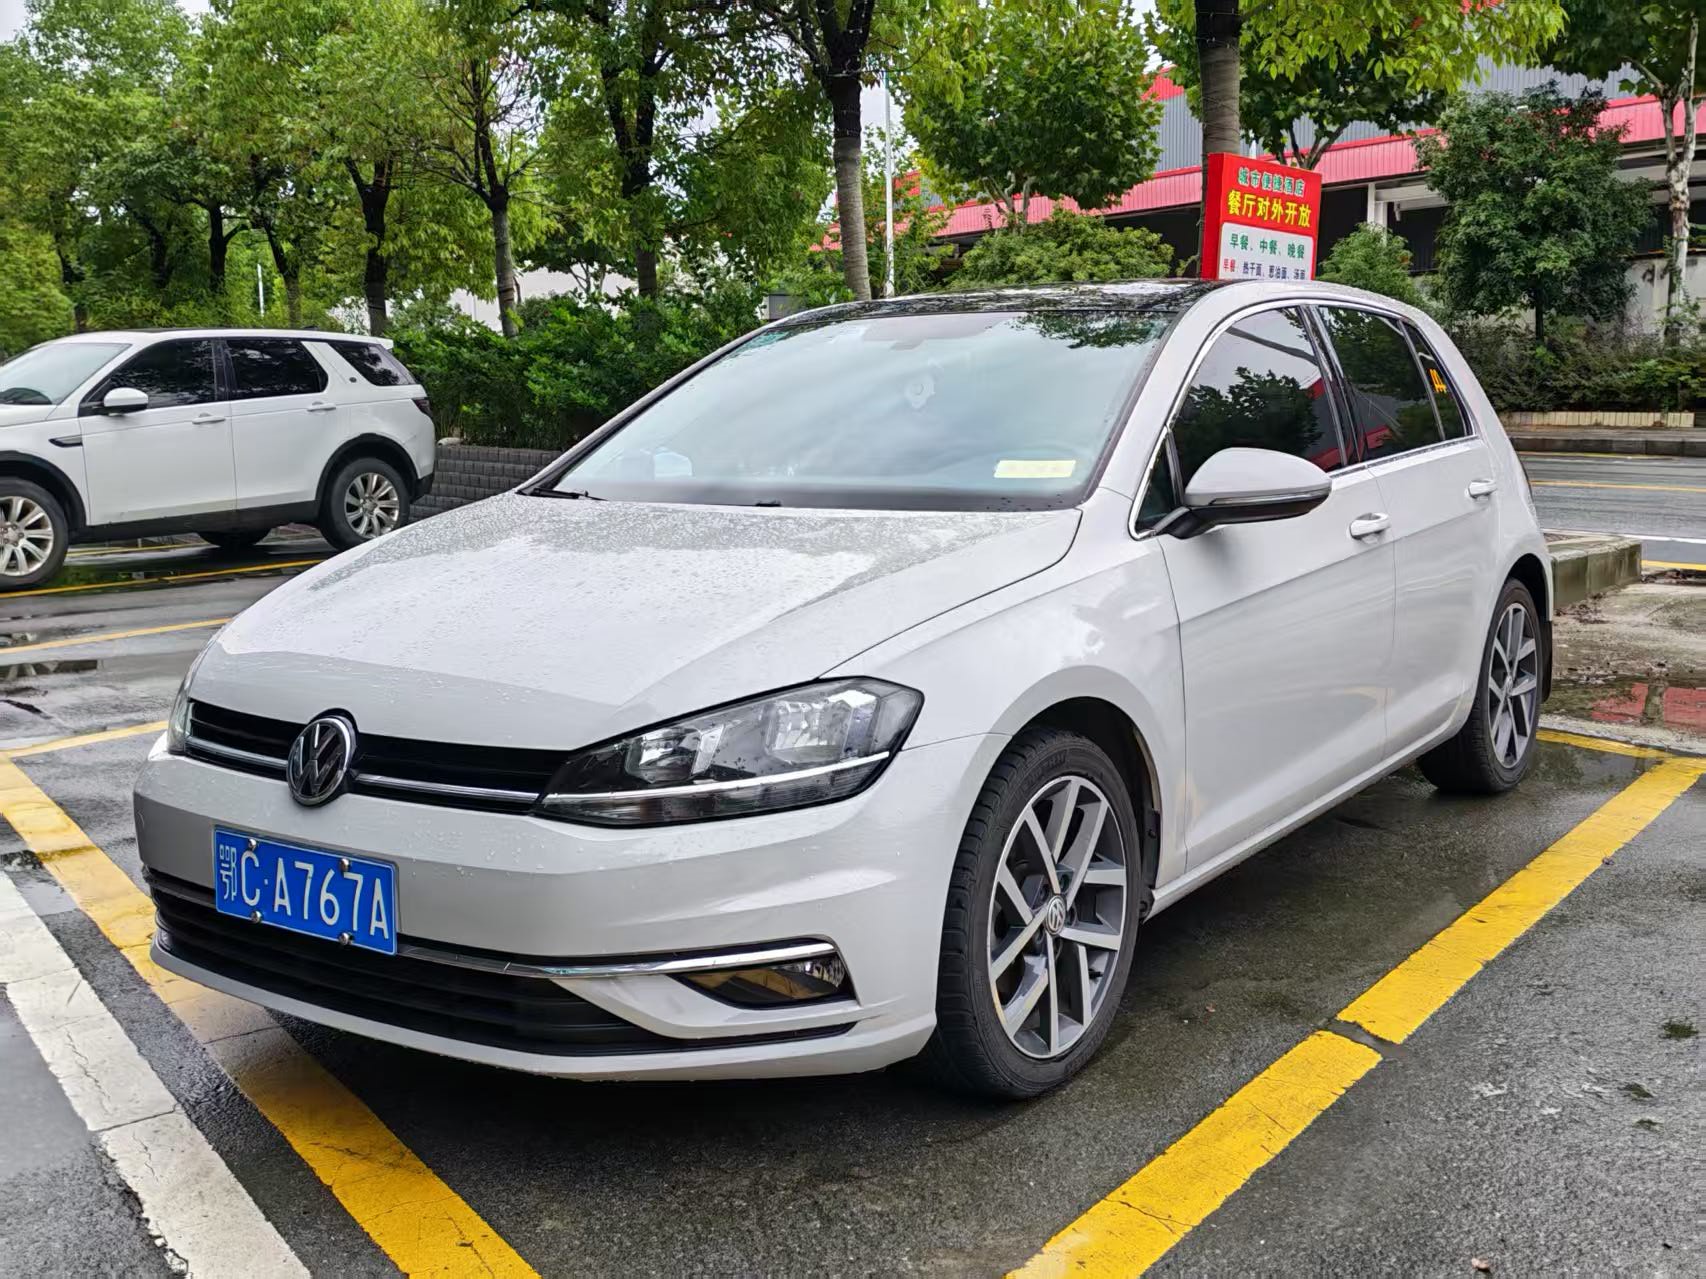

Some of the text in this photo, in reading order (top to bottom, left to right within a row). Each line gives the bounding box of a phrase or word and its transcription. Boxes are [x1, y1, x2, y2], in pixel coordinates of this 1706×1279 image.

[1237, 166, 1305, 197] 城市便捷酒店
[1227, 189, 1312, 228] 餐厅对外开放
[219, 844, 389, 940] 鄂C·A767A
